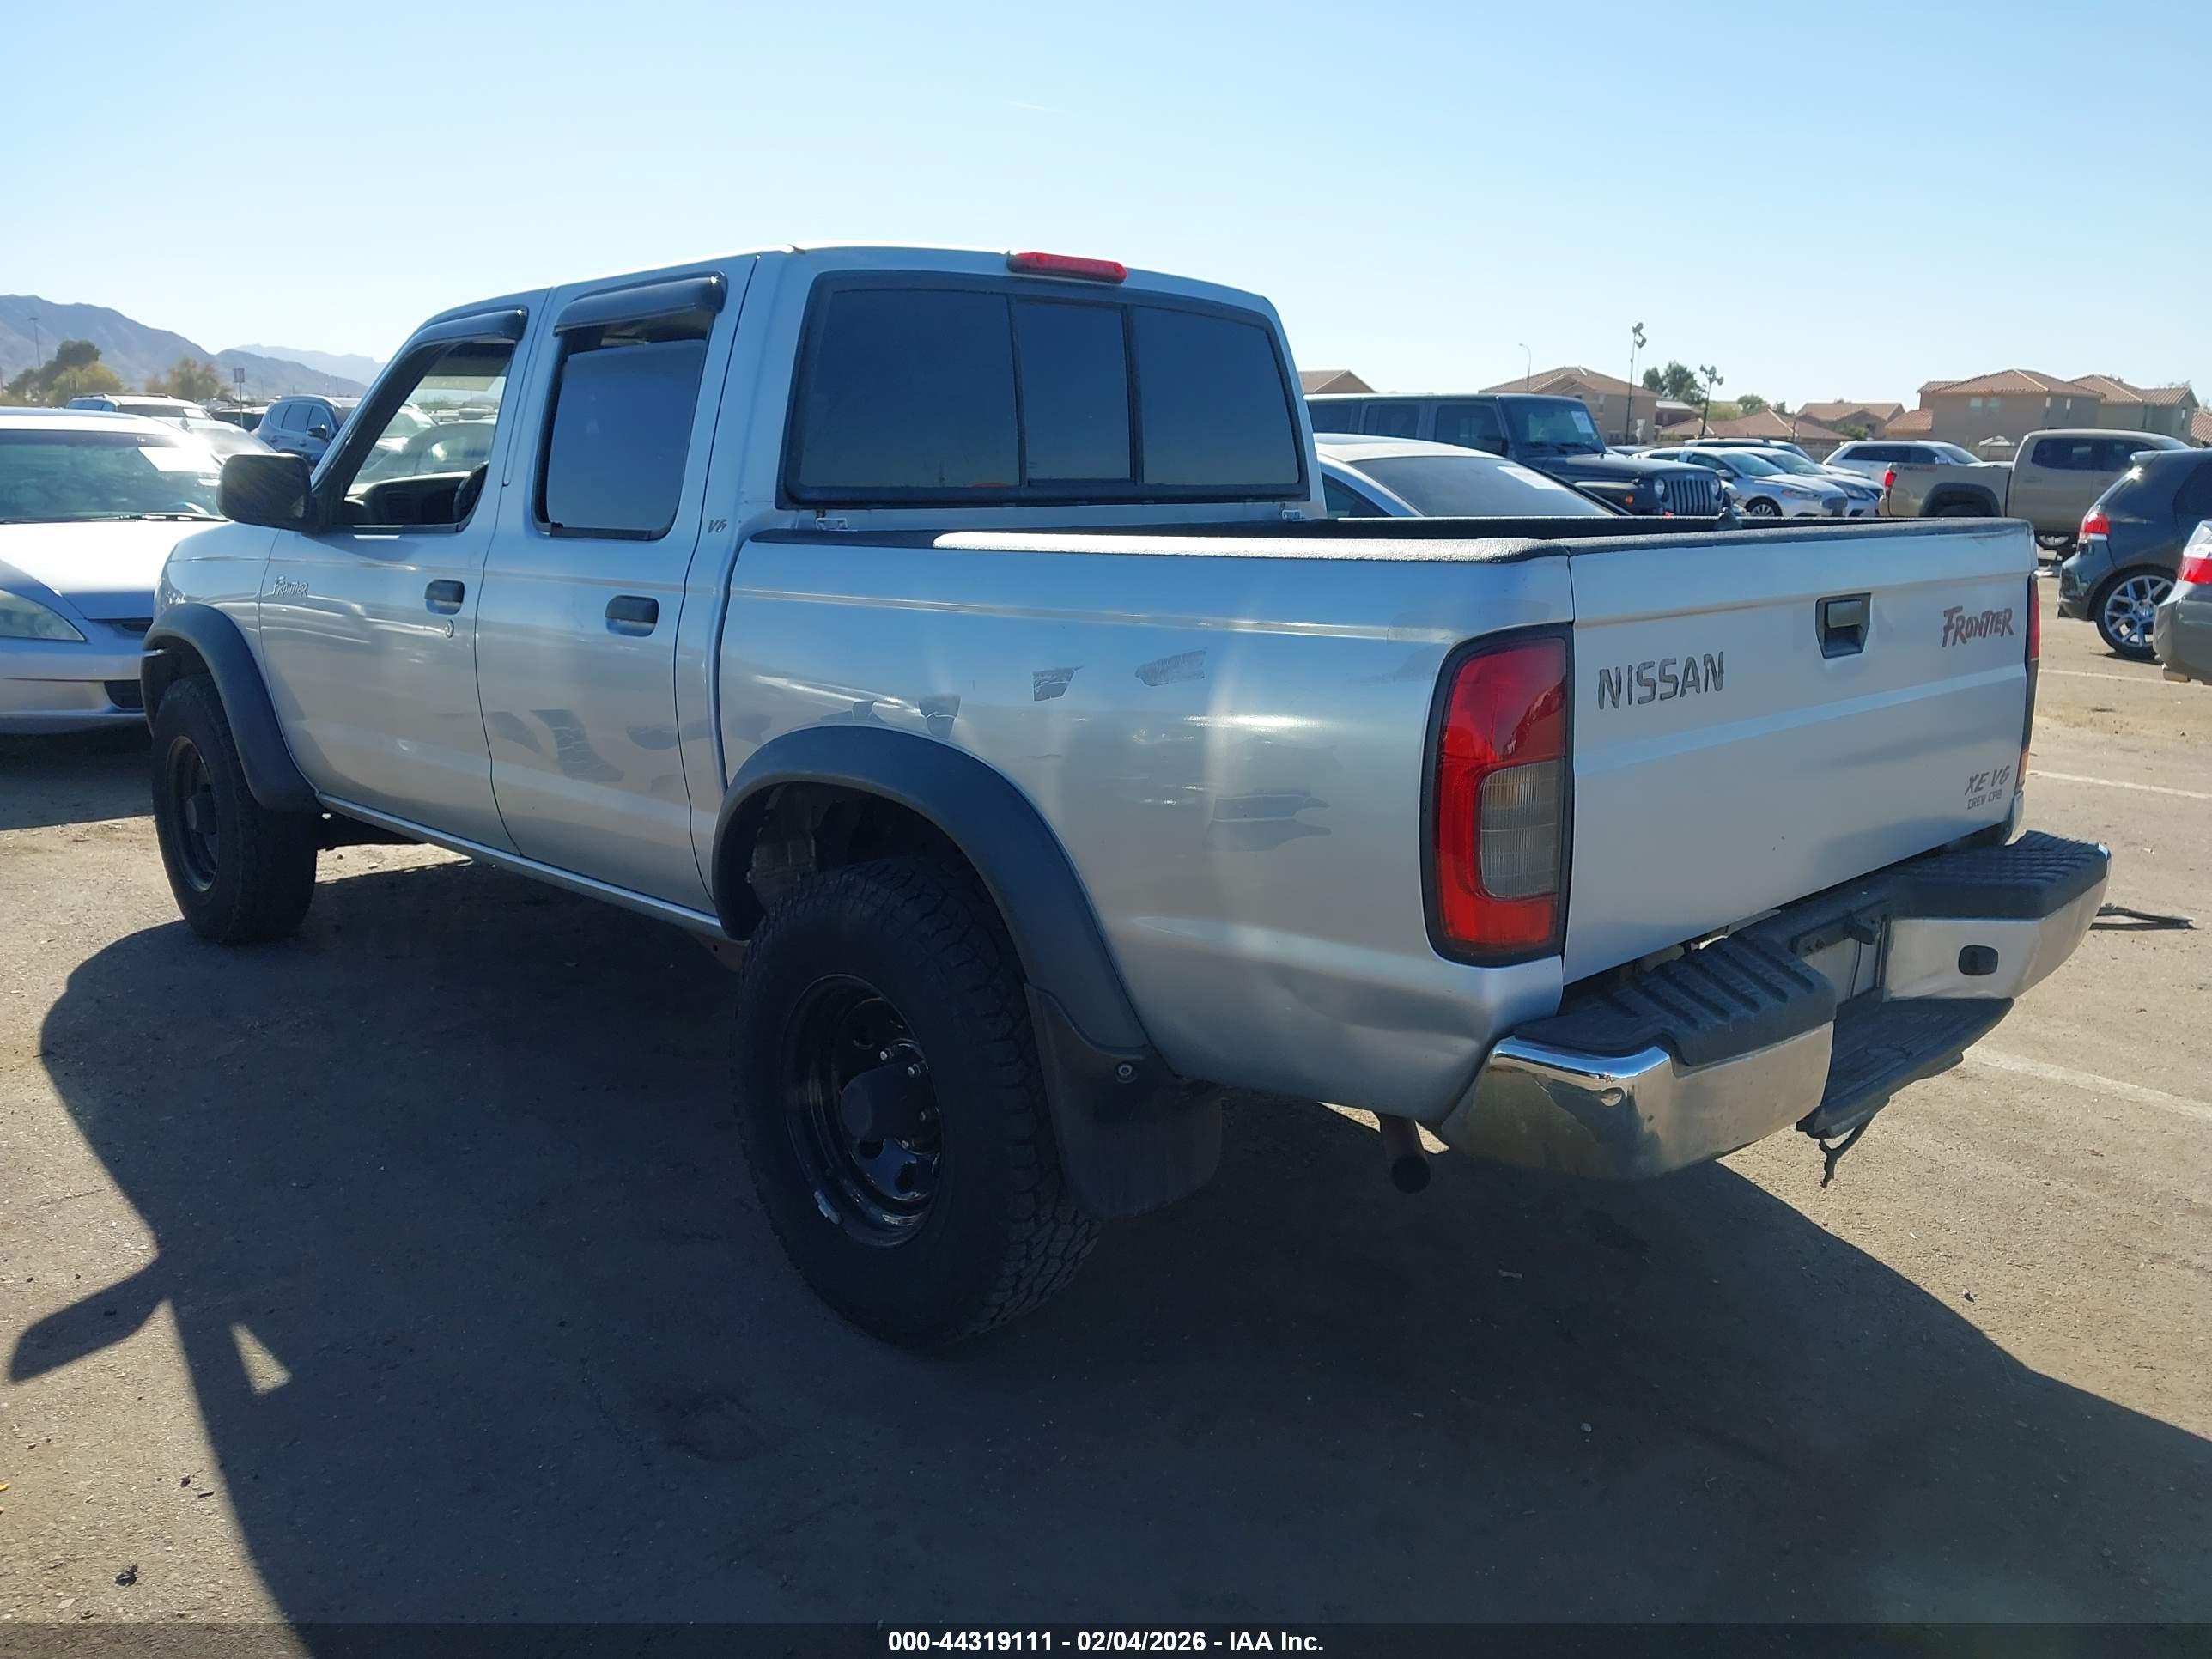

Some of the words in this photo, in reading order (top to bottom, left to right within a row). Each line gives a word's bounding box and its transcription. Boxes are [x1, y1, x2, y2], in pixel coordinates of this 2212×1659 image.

[708, 519, 727, 533] V6
[1598, 651, 1724, 710] NISSAN
[1965, 771, 1990, 796] XE
[1990, 764, 2011, 787] V6
